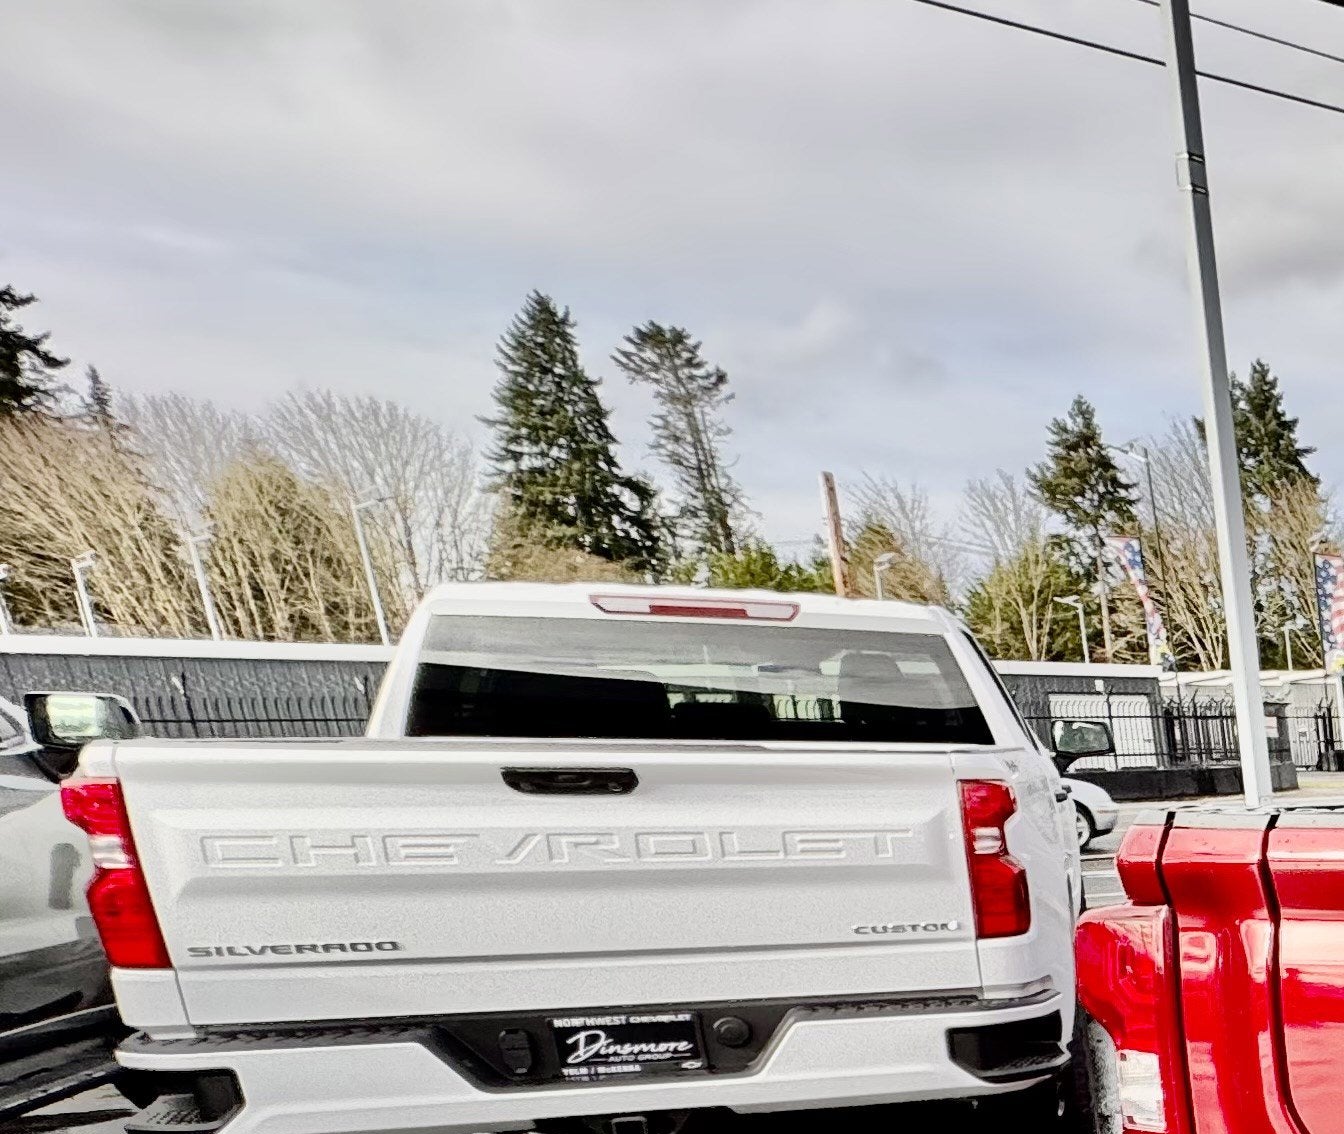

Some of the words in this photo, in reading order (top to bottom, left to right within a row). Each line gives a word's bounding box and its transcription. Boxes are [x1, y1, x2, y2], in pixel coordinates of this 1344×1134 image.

[200, 826, 914, 869] CHEVROLET
[187, 941, 402, 957] SILVERADO
[566, 1029, 694, 1064] Dinsmore
